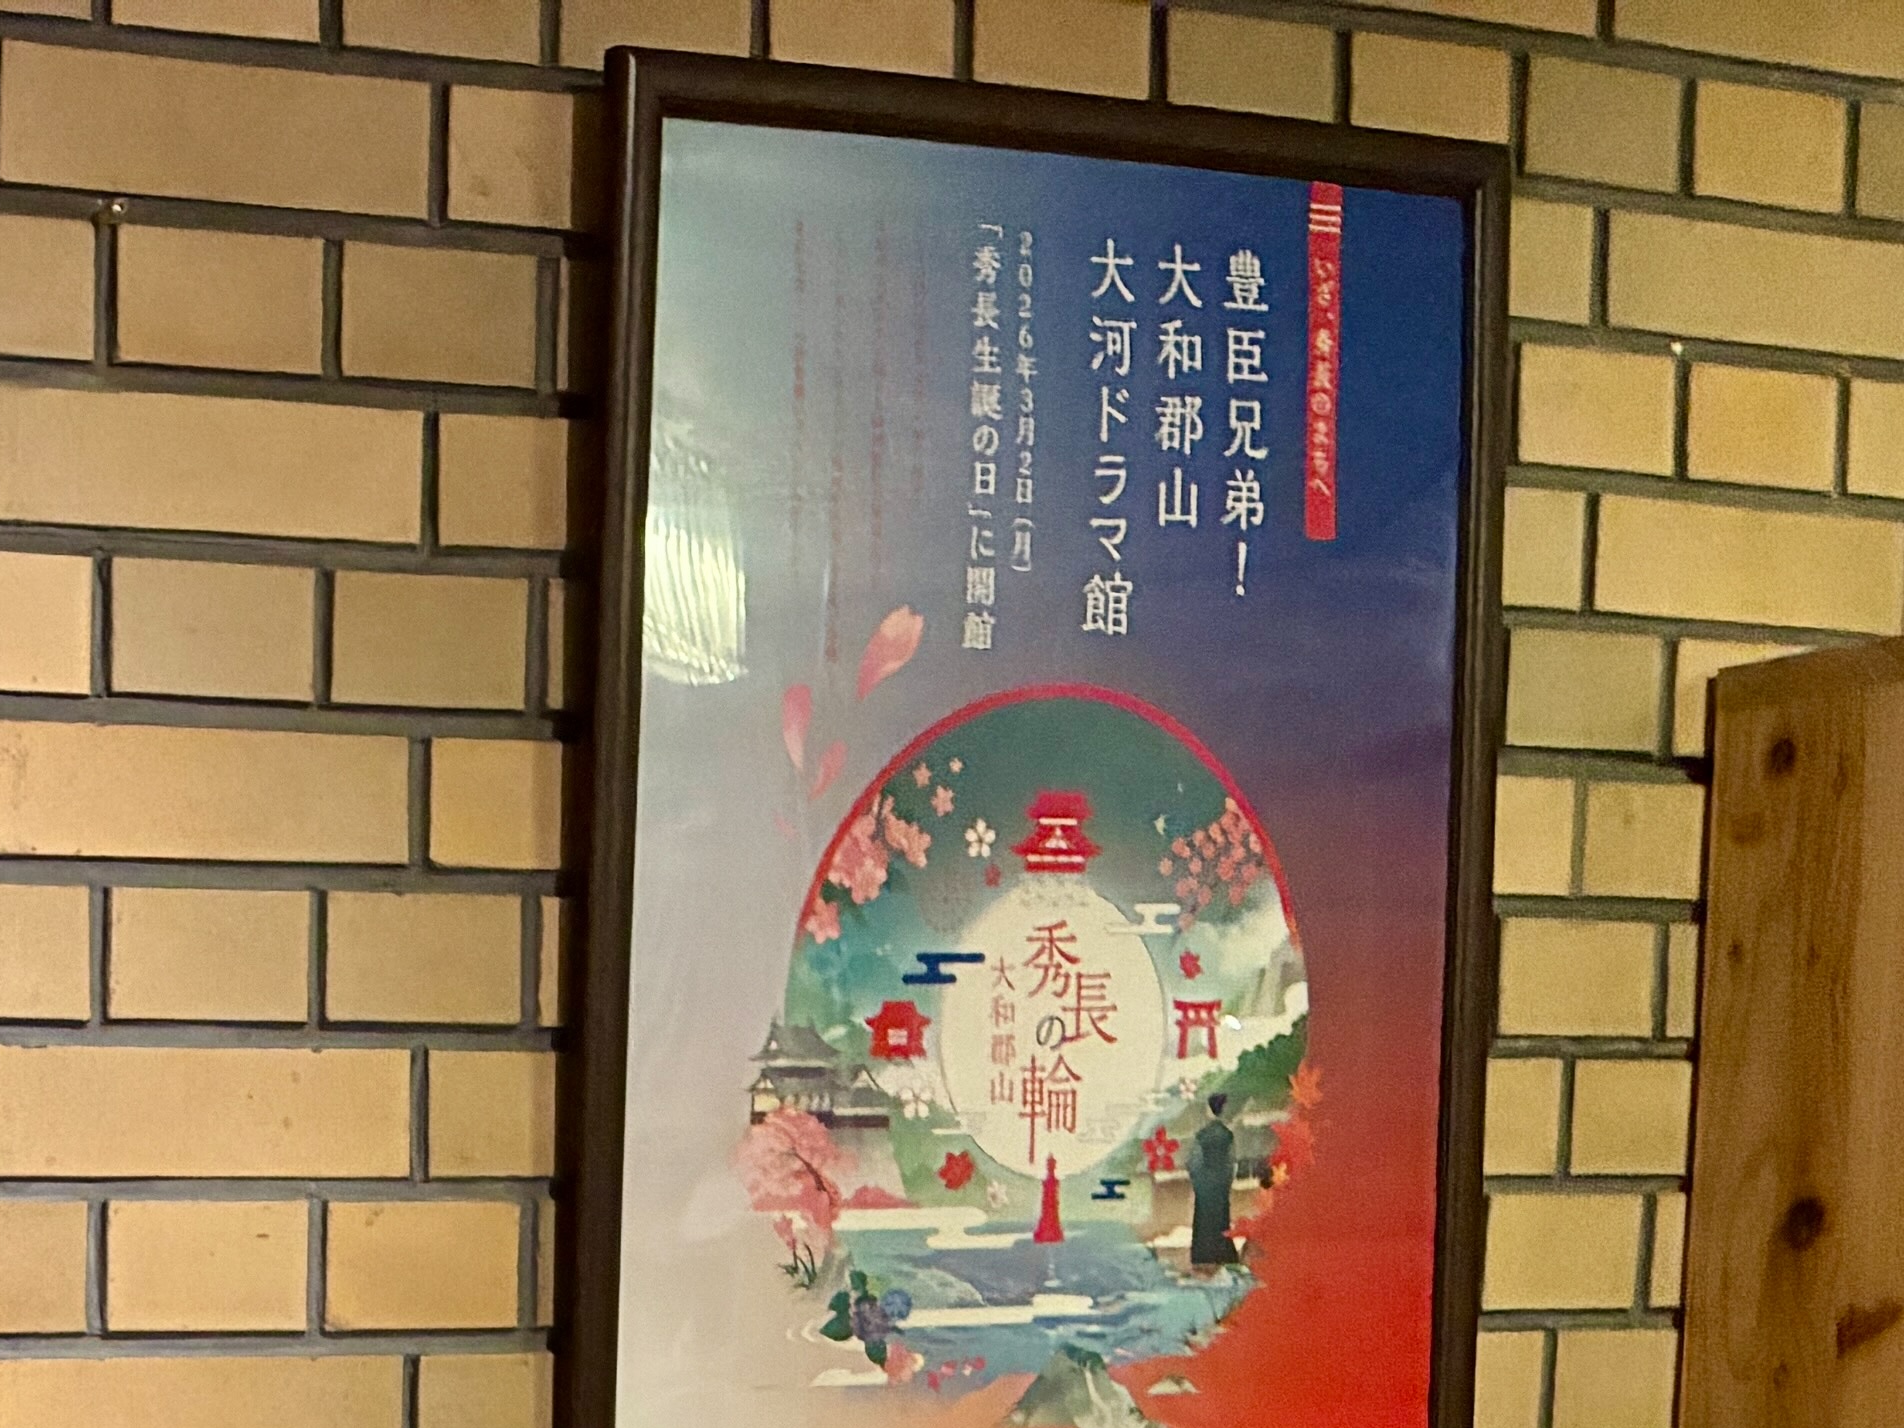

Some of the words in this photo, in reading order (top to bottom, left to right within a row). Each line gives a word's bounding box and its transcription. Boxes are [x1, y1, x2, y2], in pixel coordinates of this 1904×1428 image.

[1081, 237, 1137, 637] 大河ドラマ館
[1156, 243, 1203, 529] 大和郡山
